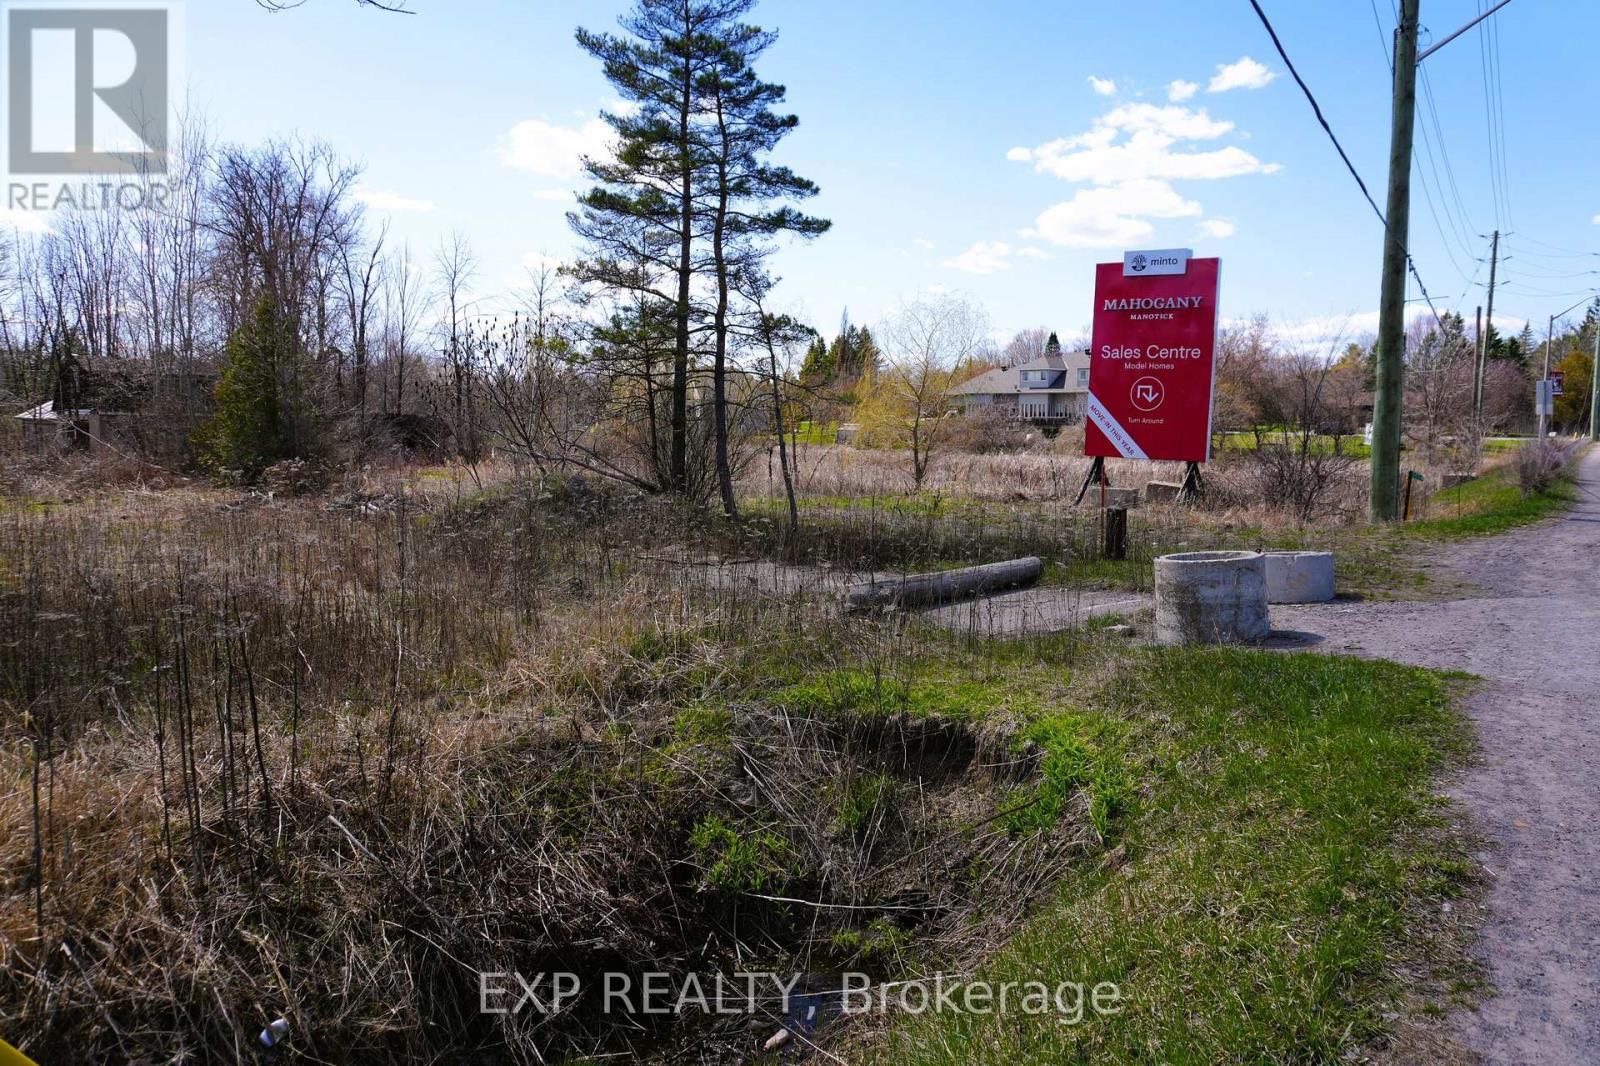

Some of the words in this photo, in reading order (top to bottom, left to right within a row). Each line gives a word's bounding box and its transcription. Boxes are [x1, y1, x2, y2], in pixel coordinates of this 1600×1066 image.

[1150, 256, 1179, 266] minto
[1103, 296, 1203, 311] MAHOGANY
[1100, 345, 1141, 359] Sales
[1146, 344, 1201, 359] Centre
[1124, 362, 1147, 370] Model
[1148, 362, 1175, 370] Homes
[1090, 404, 1112, 429] MOVE-IN
[1110, 427, 1123, 441] THIS
[1121, 440, 1135, 456] YEAR
